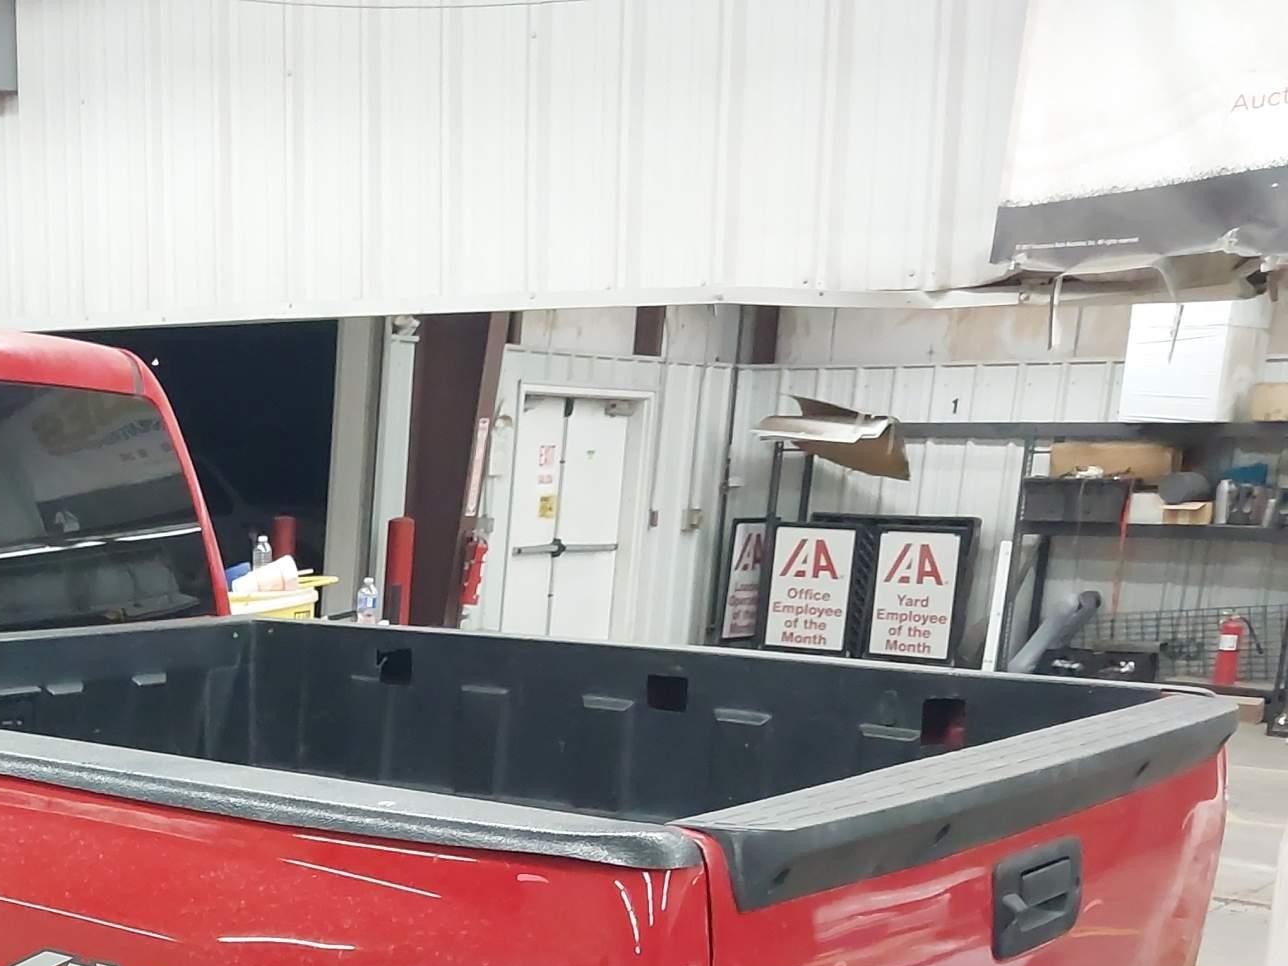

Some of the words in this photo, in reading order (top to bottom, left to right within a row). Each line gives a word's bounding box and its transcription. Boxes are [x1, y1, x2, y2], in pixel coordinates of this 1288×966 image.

[787, 587, 831, 602] Office
[897, 594, 929, 608] Yard
[772, 601, 843, 618] Employee
[876, 608, 947, 626] Employee
[784, 617, 799, 629] of
[803, 619, 827, 631] the
[781, 631, 827, 646] Month
[888, 625, 903, 636] of
[907, 626, 931, 639] the
[885, 639, 931, 655] Month
